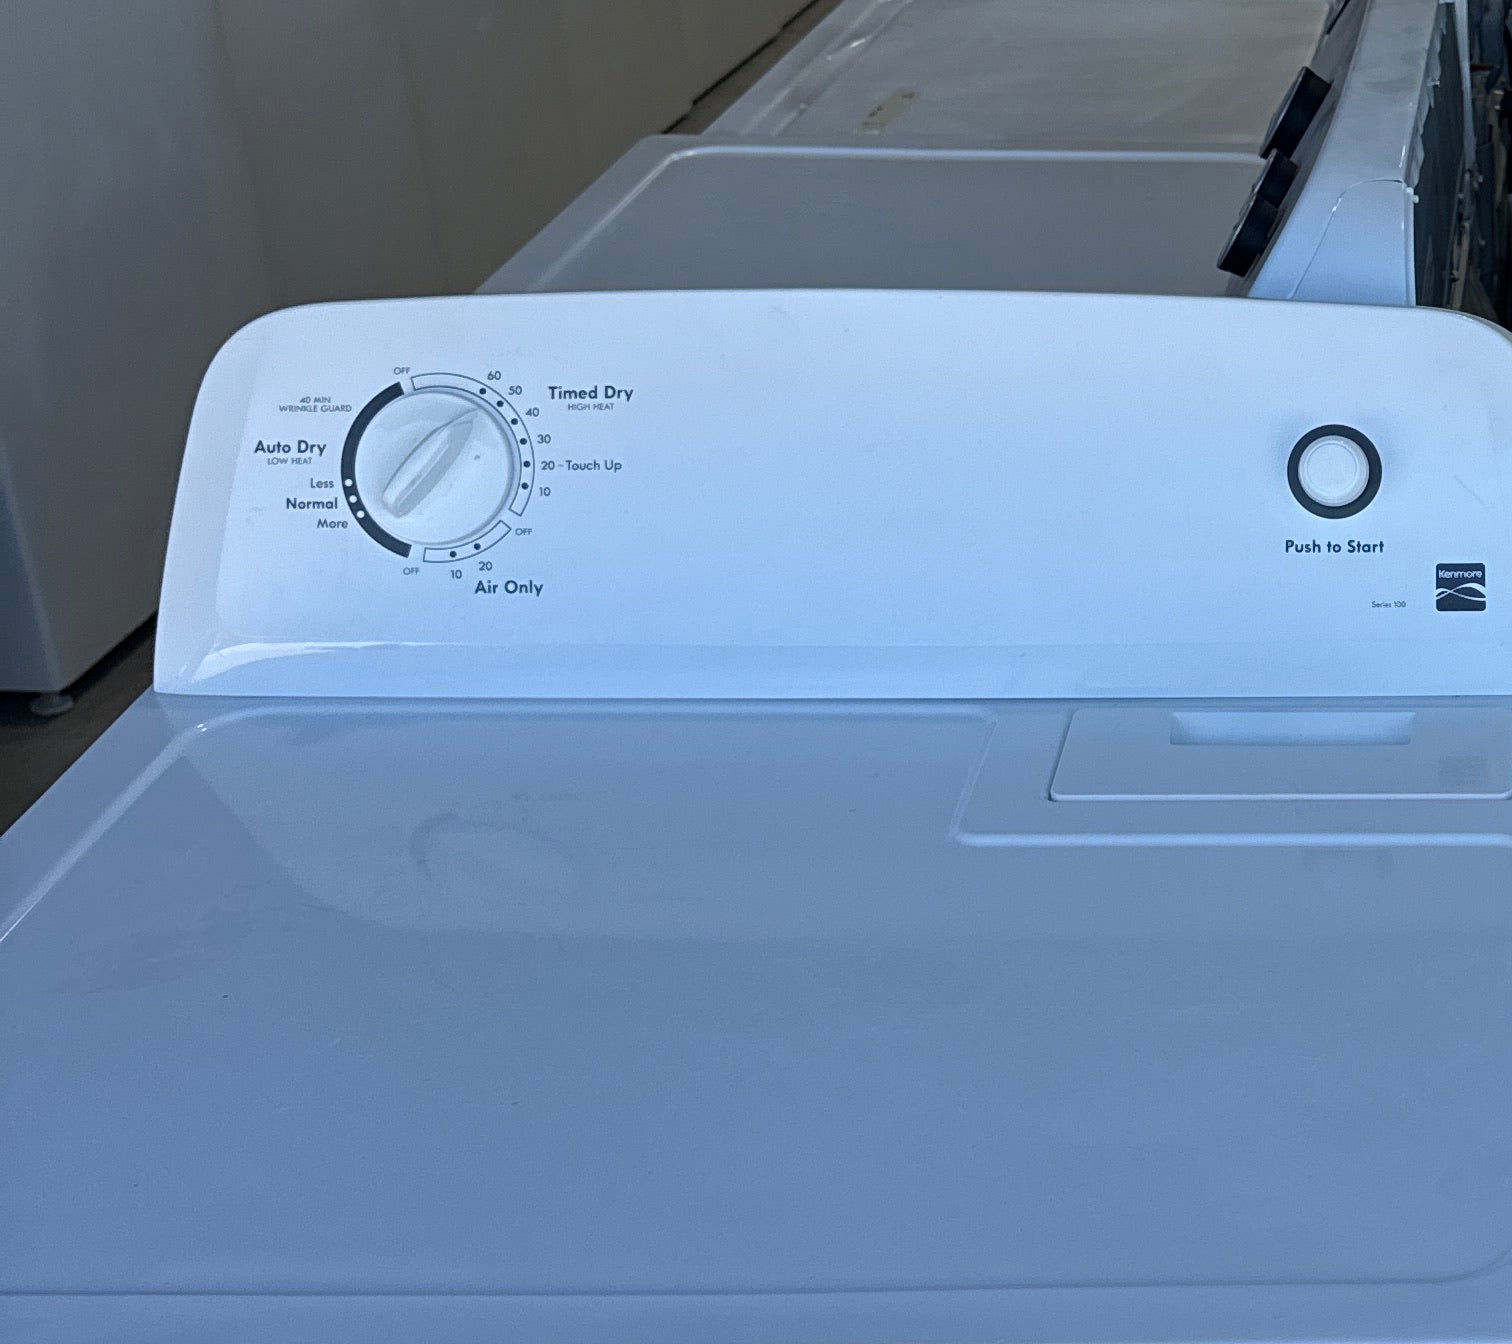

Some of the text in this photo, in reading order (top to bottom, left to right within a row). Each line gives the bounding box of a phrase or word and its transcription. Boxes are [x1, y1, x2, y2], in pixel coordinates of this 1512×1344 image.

[393, 366, 411, 375] OFF
[486, 370, 502, 381] 60
[507, 385, 523, 396] 50
[547, 385, 634, 402] Timed Dry
[313, 395, 331, 404] MIN
[278, 404, 353, 413] WRINKLE GUARD
[525, 407, 540, 417] 40
[567, 402, 615, 411] HIGH HEAT
[536, 433, 552, 444] 30
[254, 439, 327, 456] Auto Dry
[267, 457, 312, 465] LOW HEAT
[540, 459, 623, 473] 20 Touch Up
[310, 477, 335, 489] Less
[538, 486, 552, 497] 10
[285, 497, 338, 510] Normal
[316, 518, 349, 529] More
[514, 527, 533, 536] OFF
[1285, 539, 1385, 554] Push to Start
[402, 566, 420, 576] OFF
[478, 560, 493, 571] 20
[450, 569, 463, 580] 10
[1438, 569, 1483, 579] Kenmore
[474, 579, 544, 597] Air Only
[1371, 600, 1407, 609] Series 100
